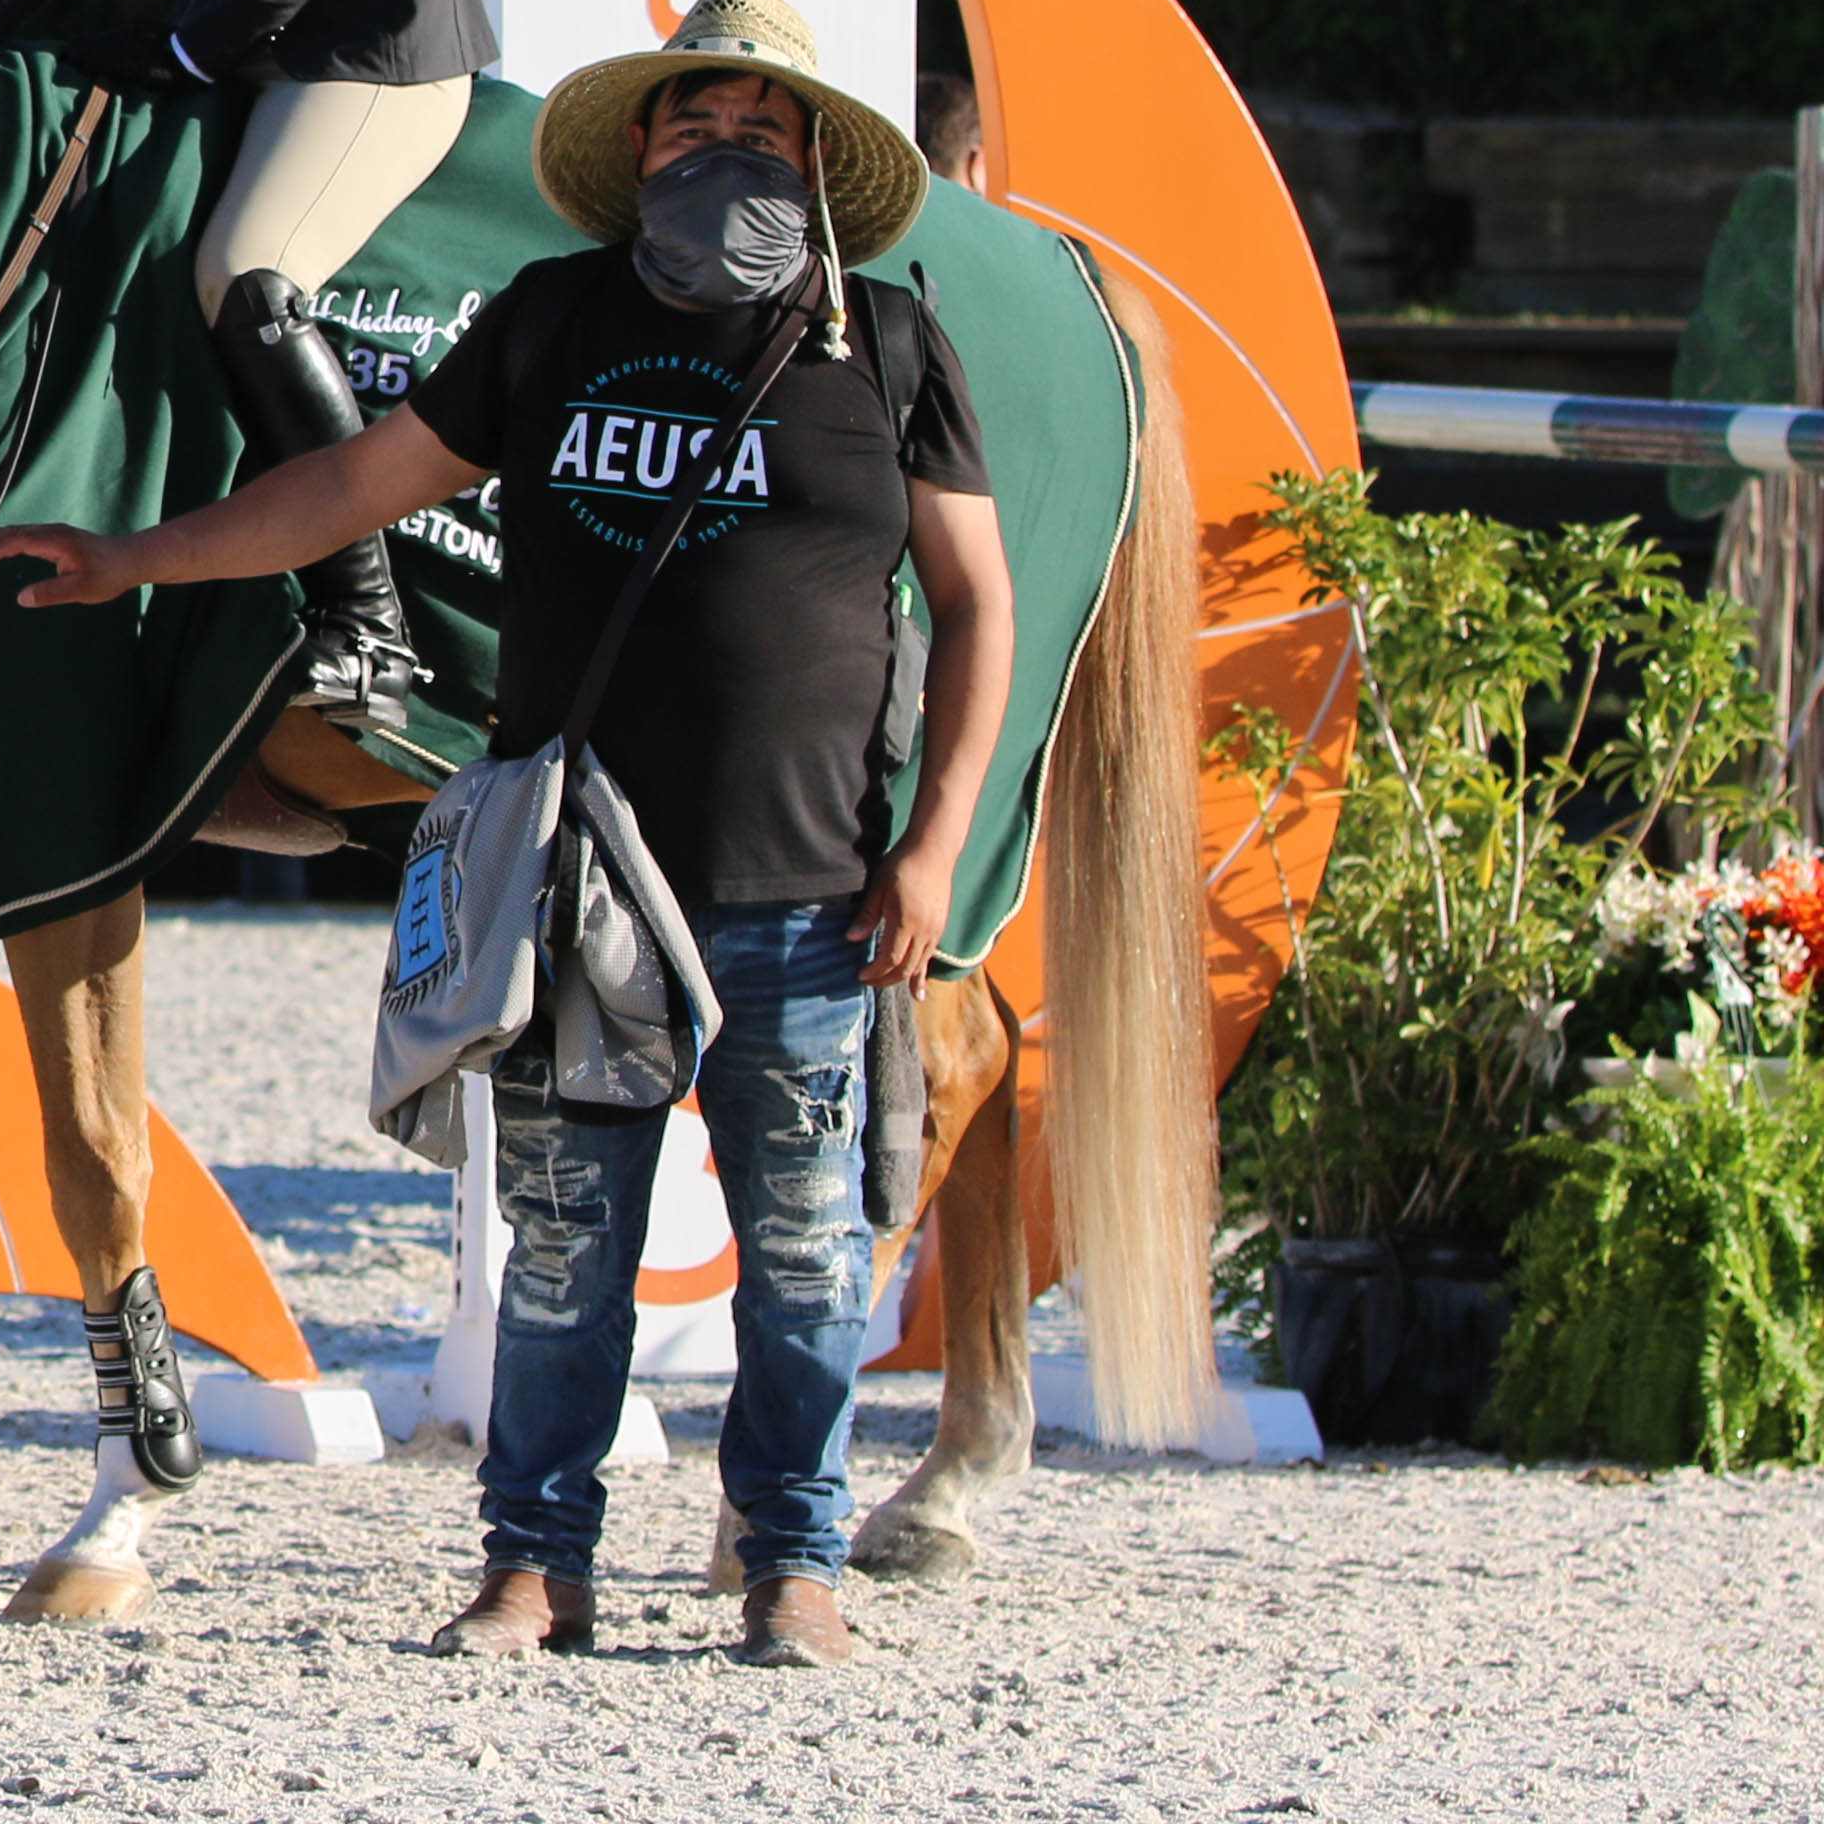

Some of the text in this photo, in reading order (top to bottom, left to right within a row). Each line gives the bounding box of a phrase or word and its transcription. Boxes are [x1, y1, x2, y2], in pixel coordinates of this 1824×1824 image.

[585, 355, 744, 395] AMERICAN EAGLE
[388, 509, 502, 574] GTON,
[569, 497, 740, 552] ESTABLISD 1977
